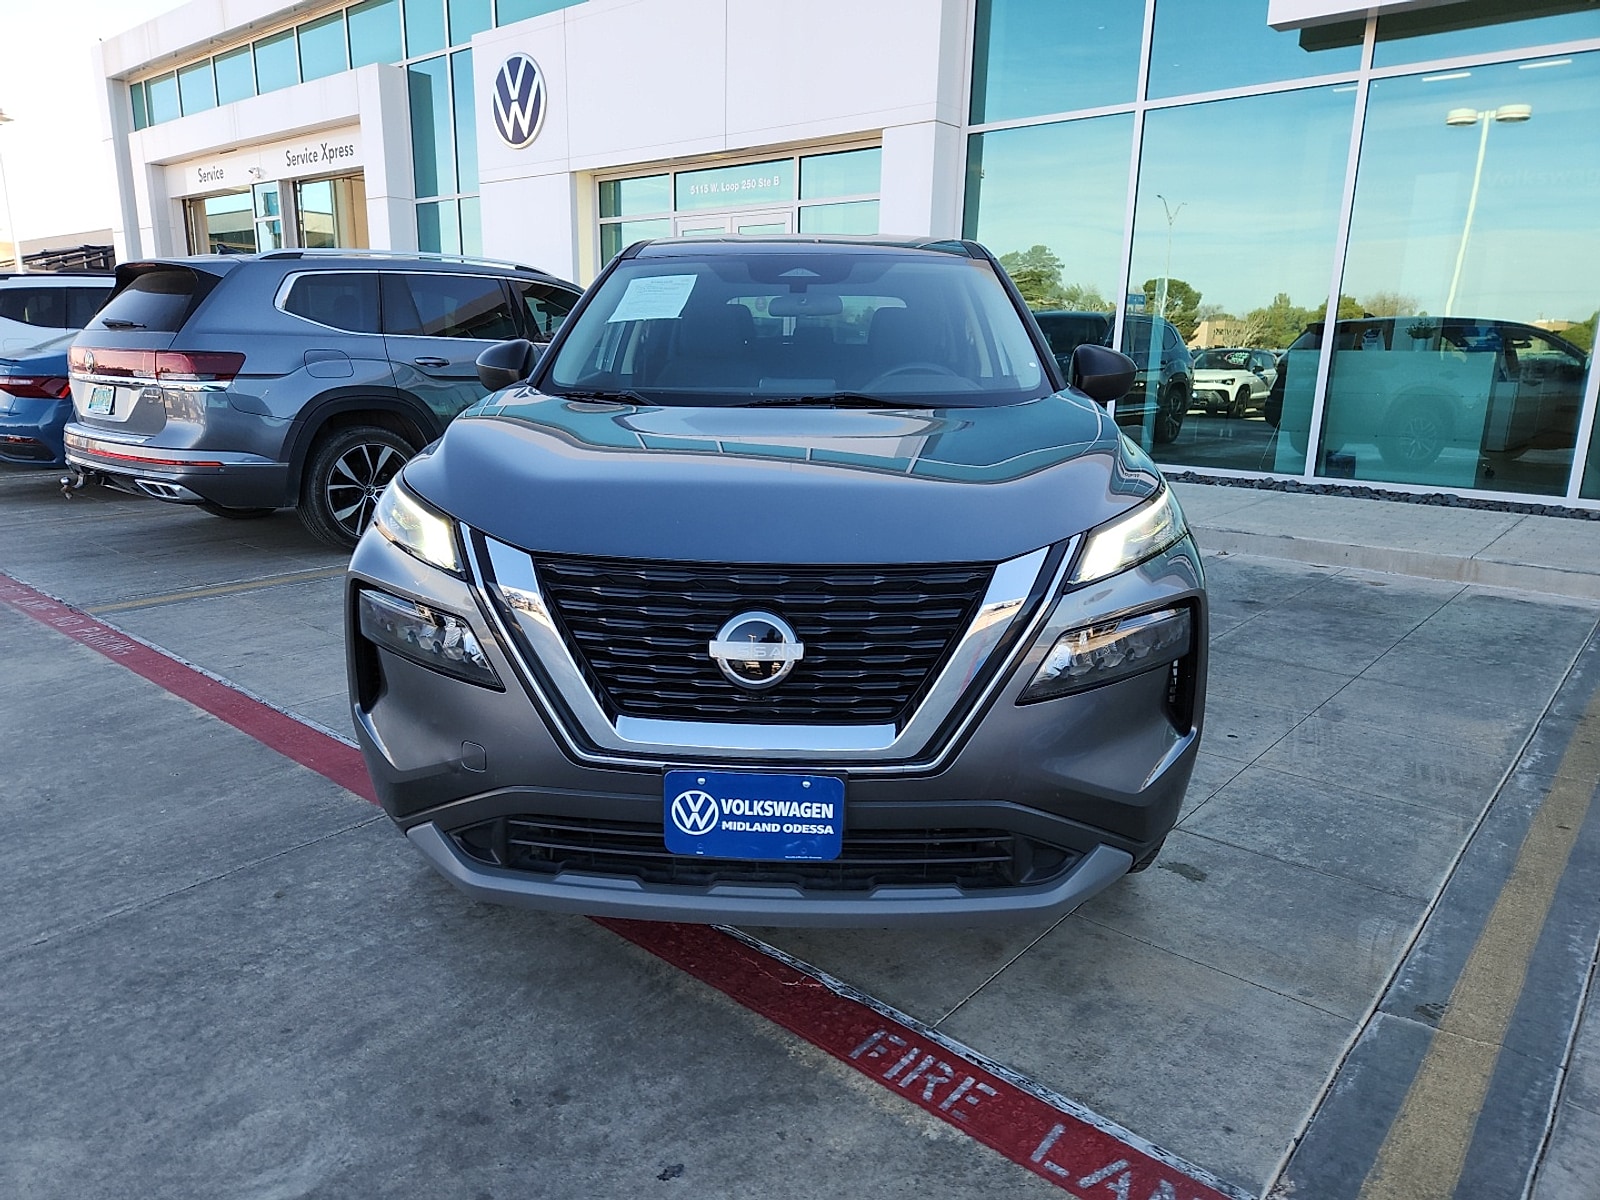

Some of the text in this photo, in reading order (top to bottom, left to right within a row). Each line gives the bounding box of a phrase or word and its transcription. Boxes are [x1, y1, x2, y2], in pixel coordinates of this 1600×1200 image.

[285, 142, 354, 167] Service Xpress
[197, 166, 225, 183] Service
[721, 182, 740, 192] Loop
[741, 178, 757, 190] 250
[758, 177, 772, 188] Ste
[773, 175, 780, 186] B
[720, 798, 834, 819] VOLKSWAGEN
[721, 820, 834, 835] MIDLAND ODESSA
[849, 1029, 999, 1120] FIRE
